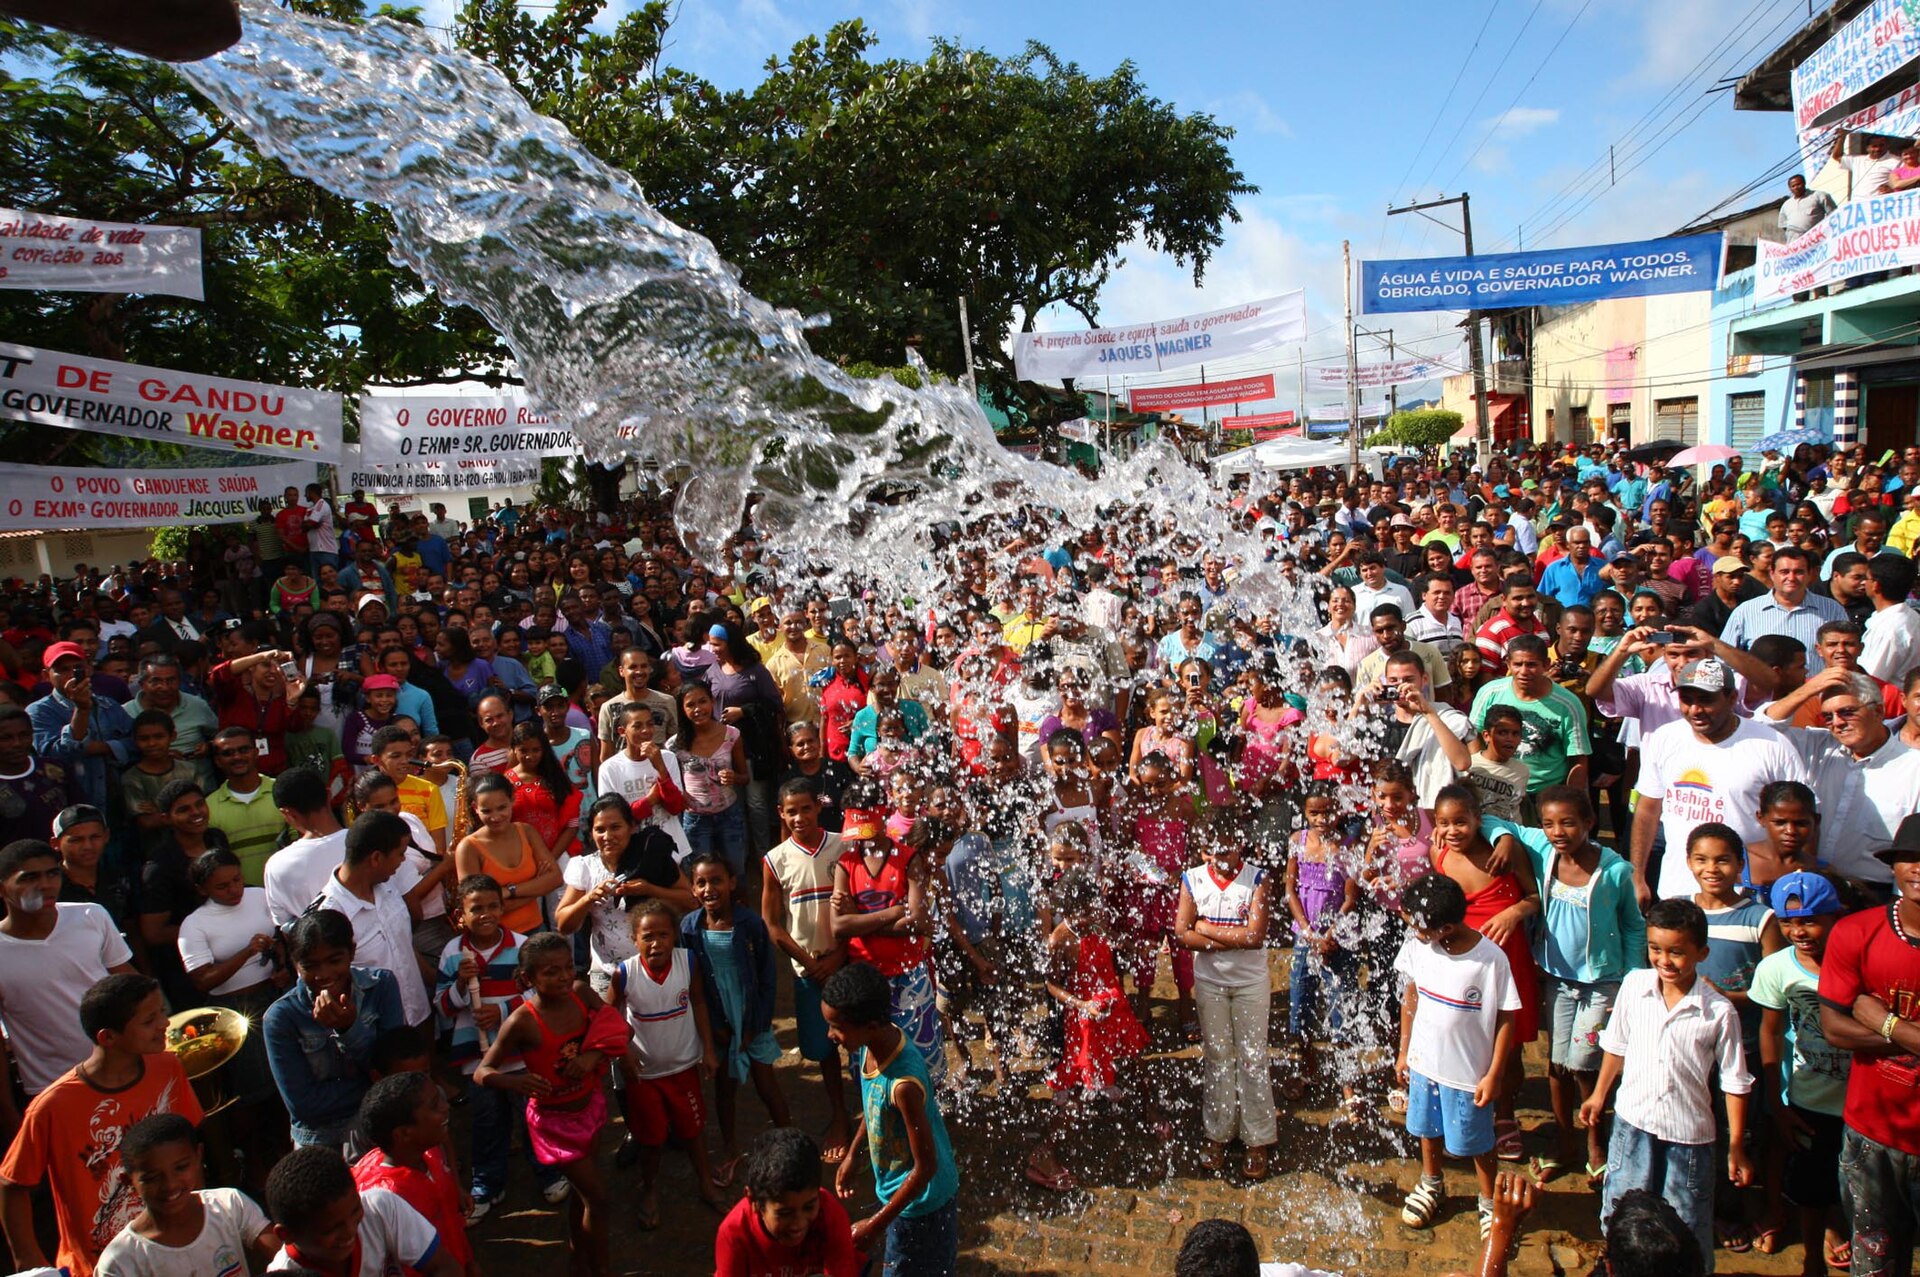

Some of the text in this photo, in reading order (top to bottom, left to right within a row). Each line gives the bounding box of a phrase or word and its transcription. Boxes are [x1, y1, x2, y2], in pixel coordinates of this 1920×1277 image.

[1865, 43, 1902, 83] ESTA
[1829, 190, 1920, 240] ELZA BRIT
[79, 226, 103, 243] de
[107, 228, 145, 245] vida
[1834, 223, 1901, 261] JACQUES
[12, 246, 125, 266] coração aos
[1379, 251, 1691, 286] ÁGUA É VIDA E SAÚDE PARA TODOS.
[1379, 264, 1698, 299] OBRIGADO, GOVERNADOR WAGNER.
[1119, 332, 1125, 340] e
[1194, 320, 1200, 330] o
[1201, 305, 1262, 332] governador
[1098, 333, 1213, 363] JAQUES WAGNER
[56, 363, 113, 394] DE
[138, 378, 285, 417] GANDU
[2, 388, 320, 450] GOVERNADOR Wagner.
[396, 408, 410, 427] O
[427, 407, 507, 427] GOVERNO
[401, 436, 412, 455] O
[490, 431, 572, 452] GOVERNADOR
[51, 473, 258, 495] O POVO GANDUENSE SAÚDA
[351, 472, 403, 487] REIVINDICA
[407, 474, 413, 487] A
[415, 474, 451, 488] ESTRADA
[454, 472, 480, 486] BA-120
[8, 499, 23, 516] O
[91, 500, 180, 518] GOVERNADOR
[184, 498, 245, 518] JACQUES
[1675, 789, 1710, 808] Bahia
